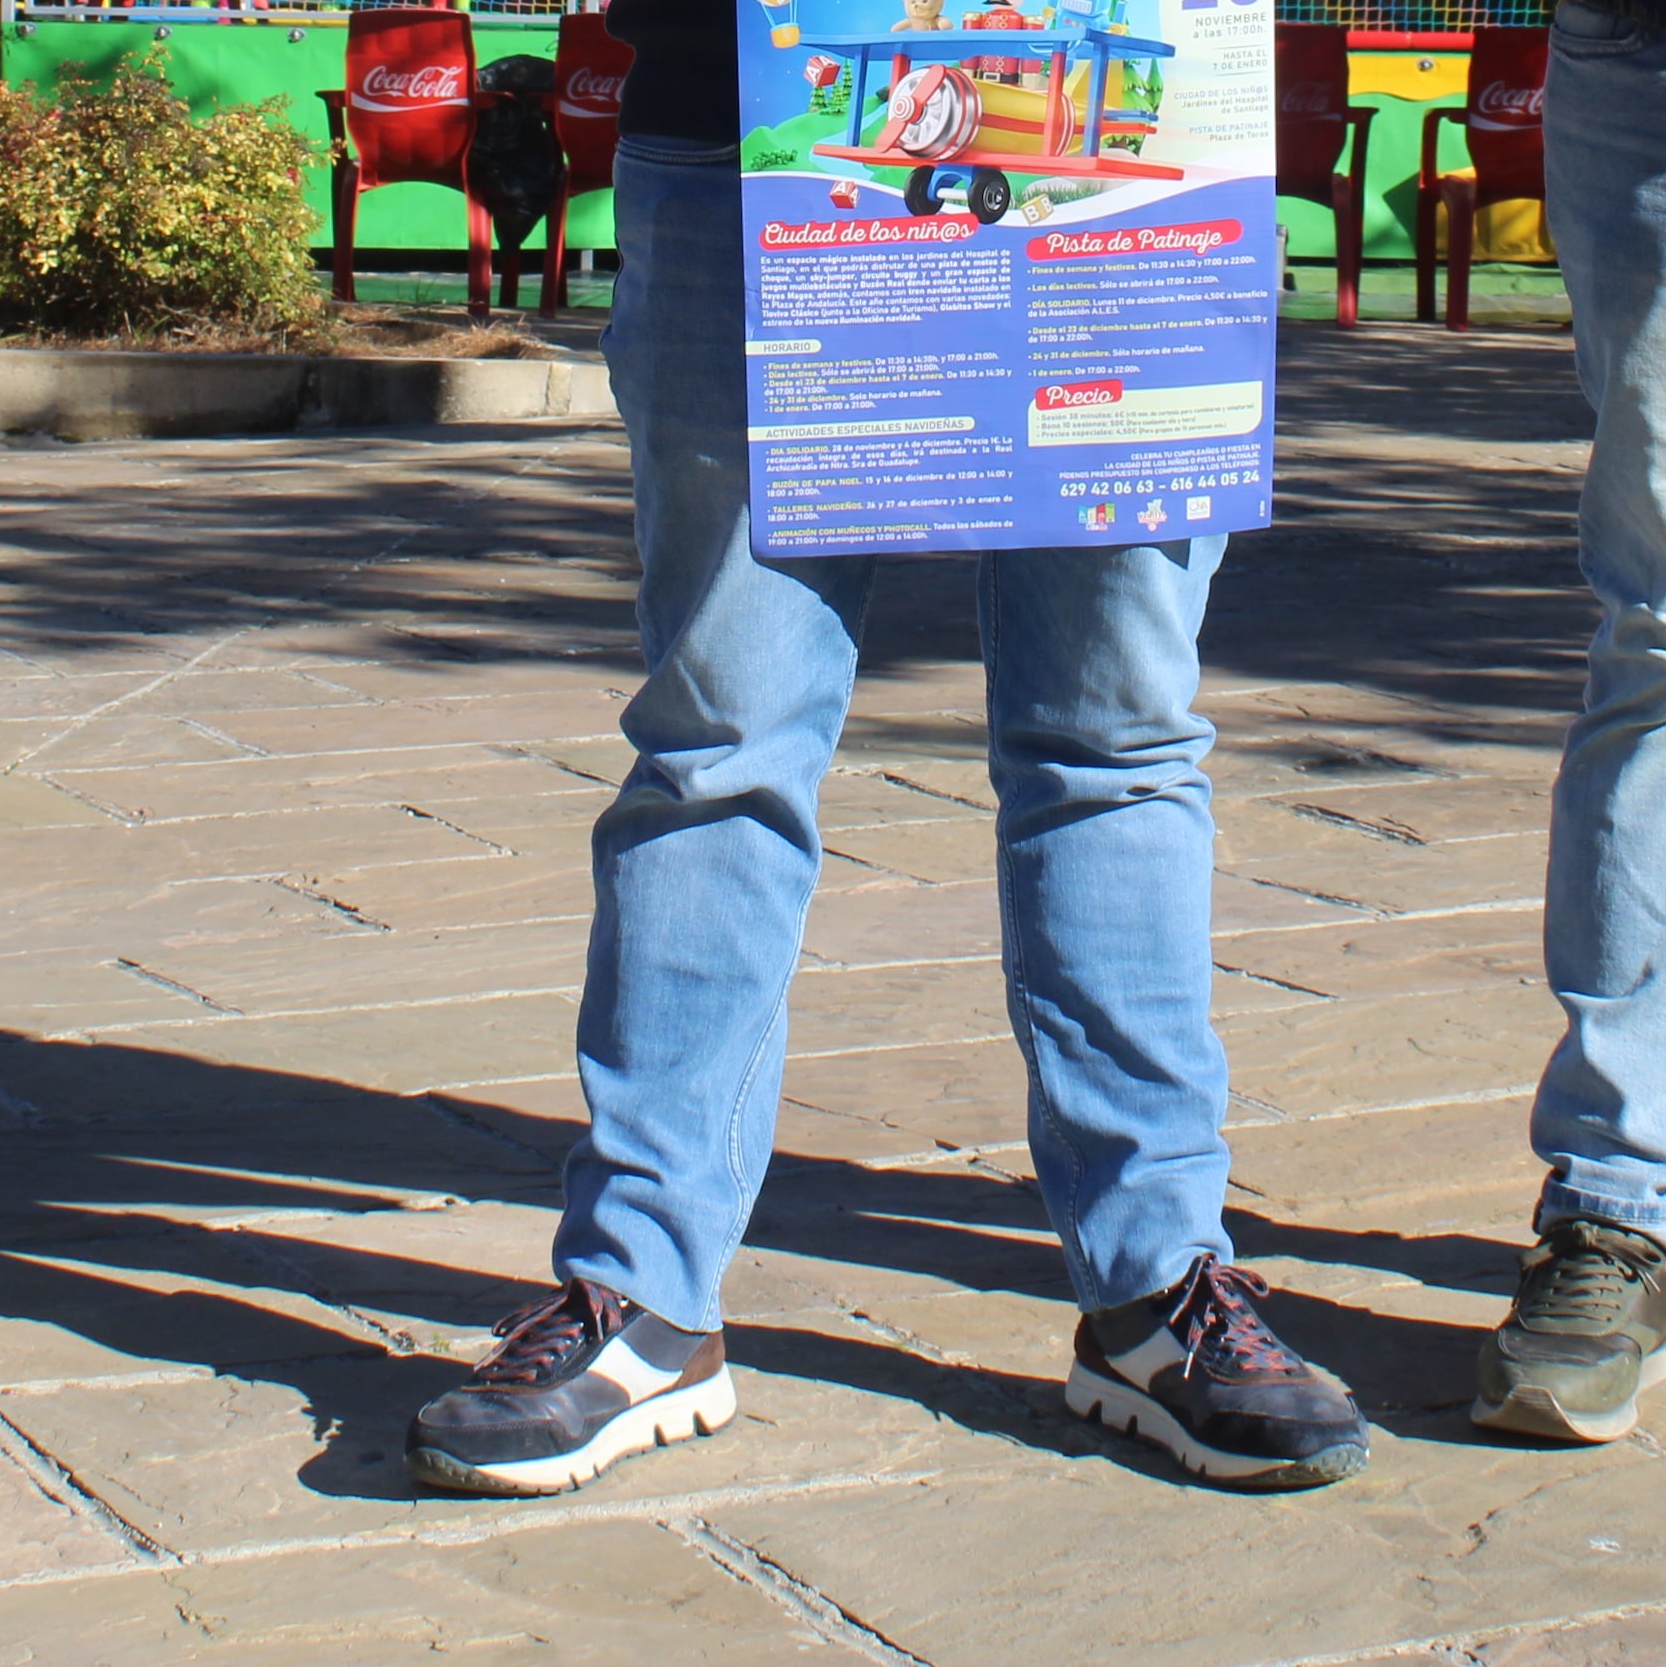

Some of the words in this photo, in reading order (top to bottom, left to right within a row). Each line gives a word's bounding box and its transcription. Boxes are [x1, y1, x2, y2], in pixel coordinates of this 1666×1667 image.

[1196, 12, 1267, 27] NOVIEMBRE
[1204, 27, 1222, 38] las
[1227, 24, 1267, 36] 17:00h.
[1223, 50, 1253, 60] HASTA
[1257, 49, 1267, 57] EL
[1221, 61, 1233, 70] DE
[1237, 59, 1268, 70] ENERO
[566, 67, 624, 102] Coca-
[1174, 90, 1205, 100] CIUDAD
[1208, 89, 1219, 98] DE
[1222, 88, 1238, 97] LOS
[1182, 98, 1217, 108] Jardines
[1220, 97, 1233, 106] del
[1236, 94, 1268, 107] Hospital
[1221, 105, 1231, 114] de
[1234, 103, 1269, 115] Santiago
[1189, 125, 1213, 134] PISTA
[1216, 124, 1227, 132] DE
[1230, 121, 1268, 131] PATINAJE
[1210, 133, 1232, 142] Plaza
[1235, 132, 1245, 140] de
[765, 222, 837, 245] Ciudad
[840, 223, 866, 242] de
[870, 221, 906, 241] los
[907, 221, 974, 245] niñ@s
[1047, 233, 1104, 254] Pista
[1107, 232, 1133, 251] de
[1138, 229, 1223, 254] Patinaje
[764, 342, 811, 353] HORARIO
[1046, 385, 1114, 406] Precio
[766, 427, 833, 439] ACTIVIDADES
[837, 423, 901, 436] ESPECIALES
[905, 417, 965, 433] NAVIDEÑAS
[1131, 450, 1162, 461] CELEBRA
[1164, 450, 1173, 459] TU
[1251, 443, 1260, 451] EN
[1105, 462, 1114, 470] LA
[1116, 460, 1139, 469] CIUDAD
[1141, 459, 1150, 467] DE
[1153, 458, 1166, 467] LOS
[1197, 454, 1215, 464] PISTA
[1217, 453, 1226, 461] DE
[1060, 482, 1087, 497] 629
[1091, 482, 1109, 495] 42
[1114, 480, 1132, 494] 06
[1136, 479, 1154, 493] 63
[1170, 477, 1193, 491] 616
[1197, 474, 1217, 489] 44
[1221, 472, 1238, 486] 05
[1242, 470, 1260, 483] 24
